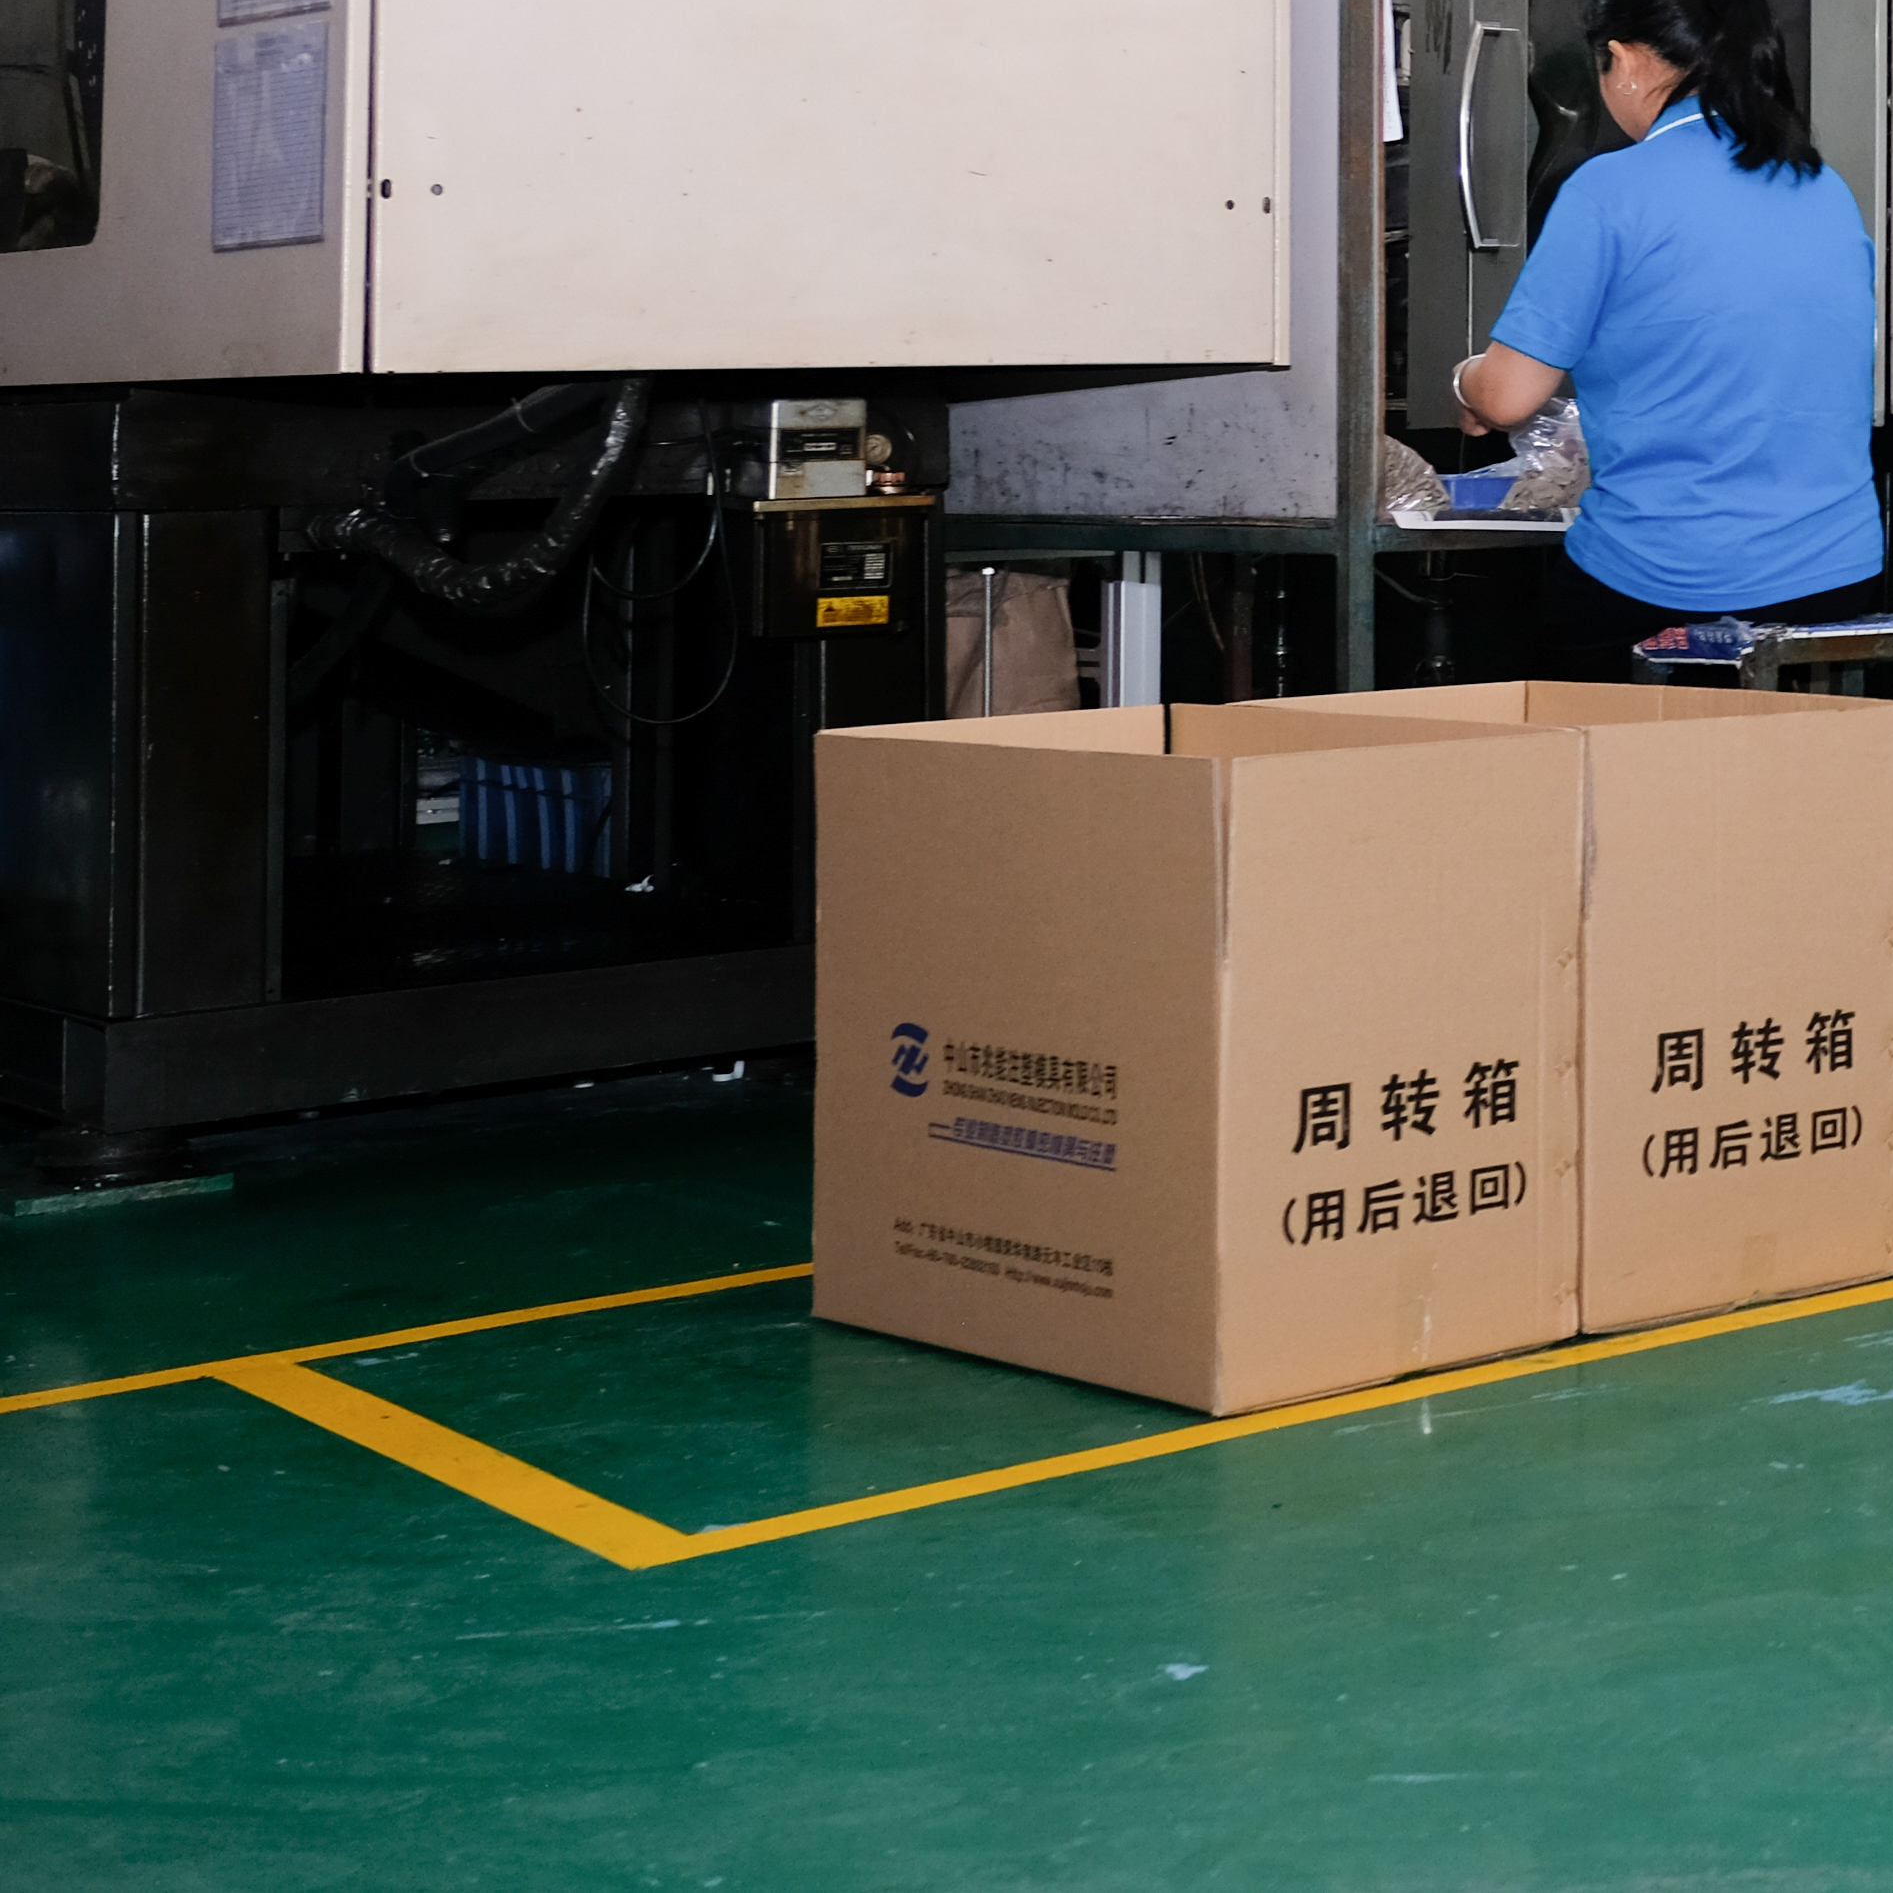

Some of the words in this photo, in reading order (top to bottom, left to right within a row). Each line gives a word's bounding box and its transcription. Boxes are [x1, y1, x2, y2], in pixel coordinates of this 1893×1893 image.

[1651, 1007, 1857, 1094] 周转箱
[1292, 1056, 1521, 1154] 周转箱
[1639, 1103, 1865, 1180] (用后退回)
[1280, 1159, 1528, 1247] (用后退回)
